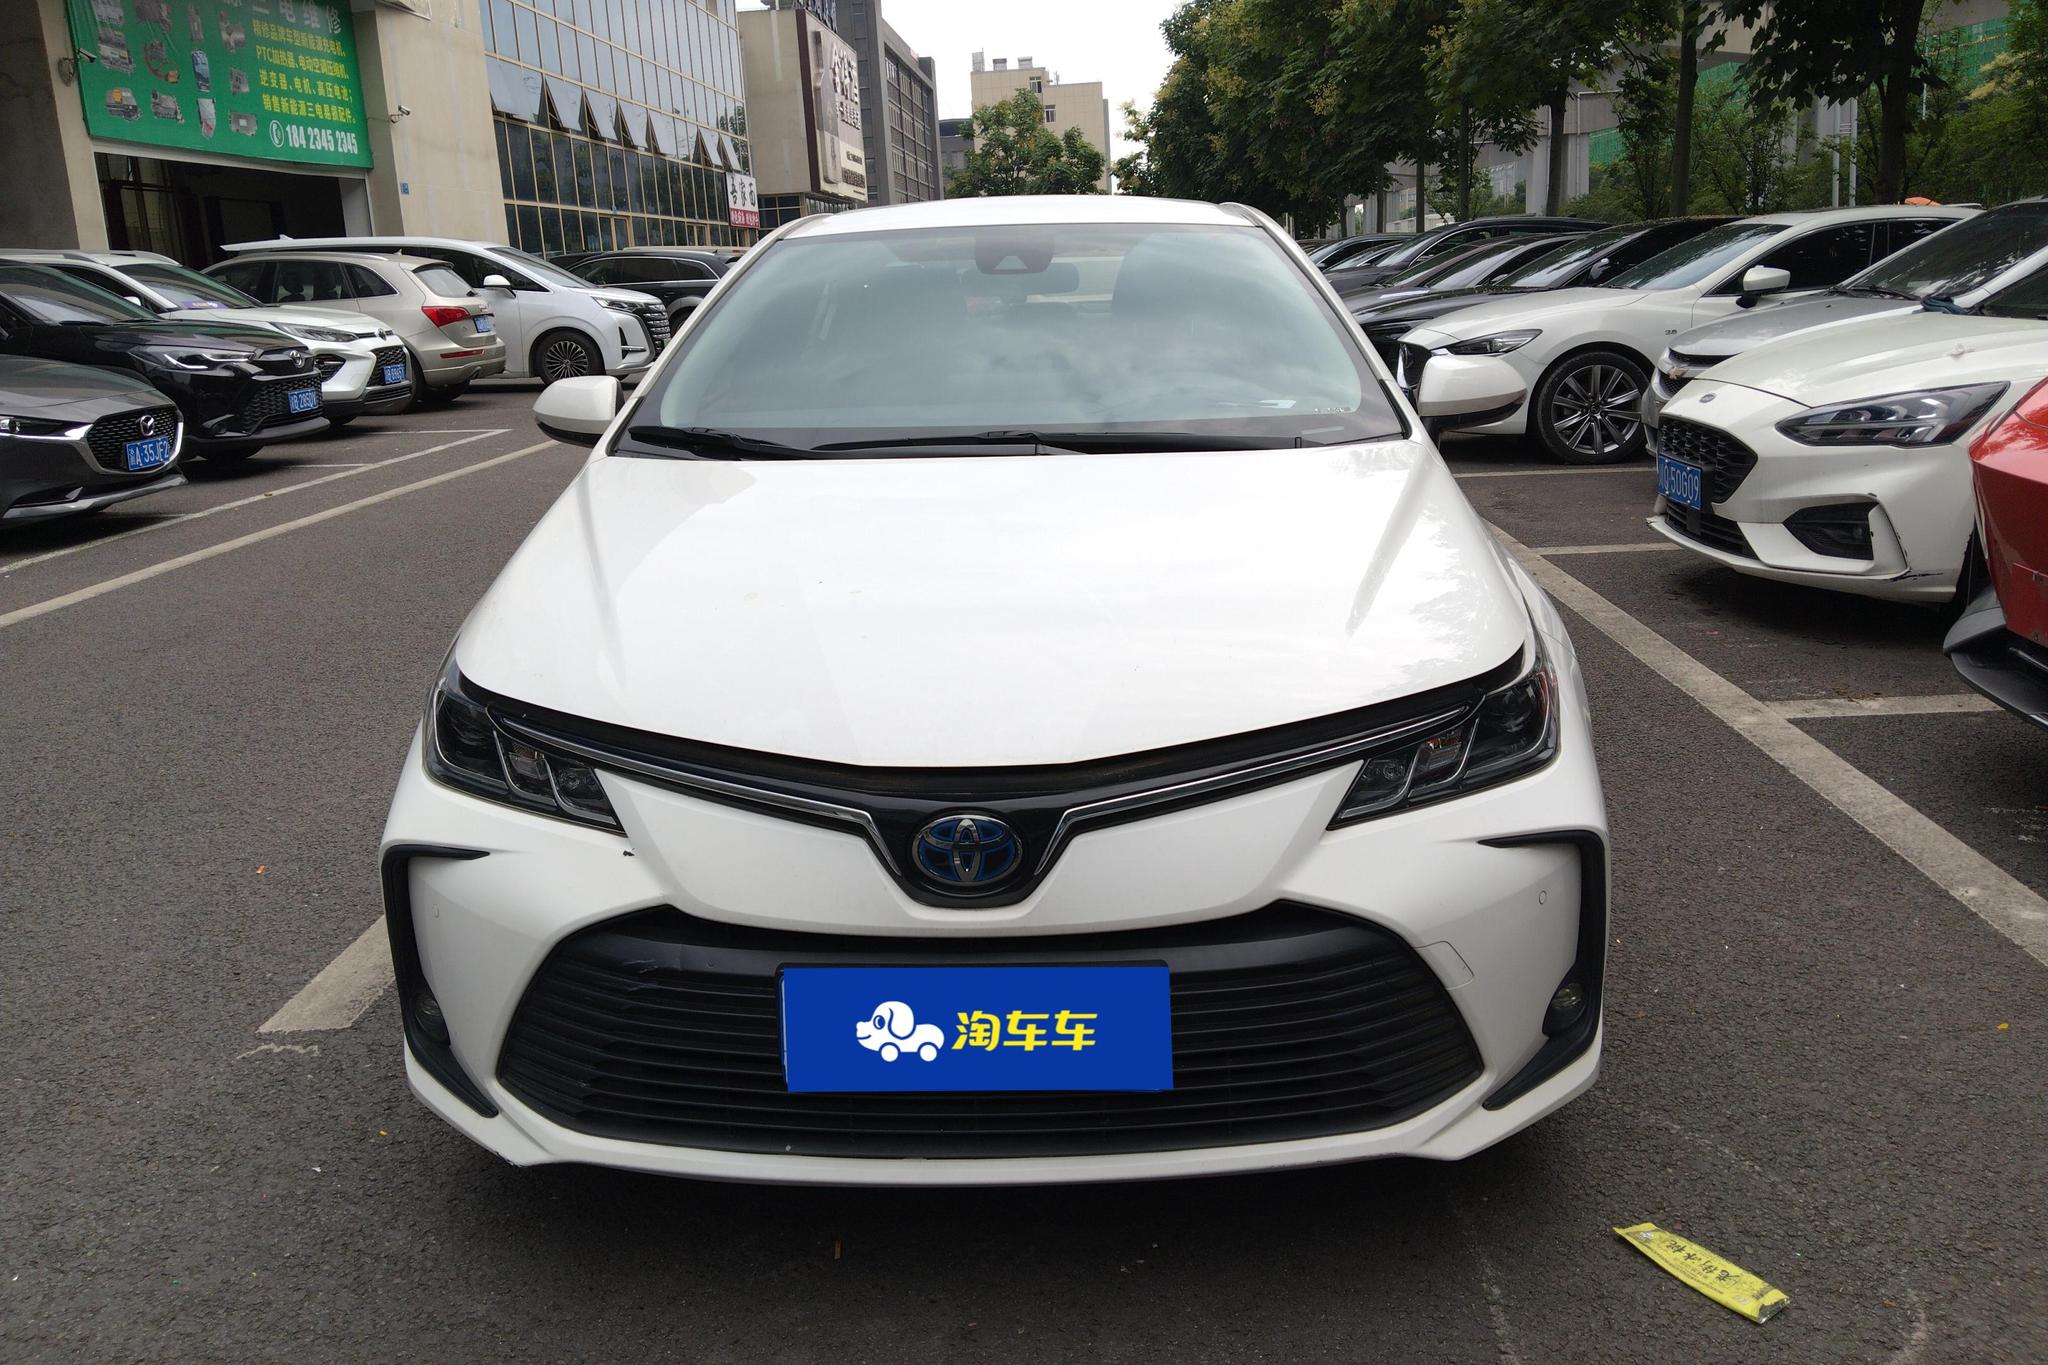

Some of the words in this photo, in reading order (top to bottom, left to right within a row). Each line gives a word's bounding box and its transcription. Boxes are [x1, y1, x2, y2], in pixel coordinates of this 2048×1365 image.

[286, 123, 306, 149] 184
[307, 126, 335, 152] 2345
[335, 130, 358, 155] 2345
